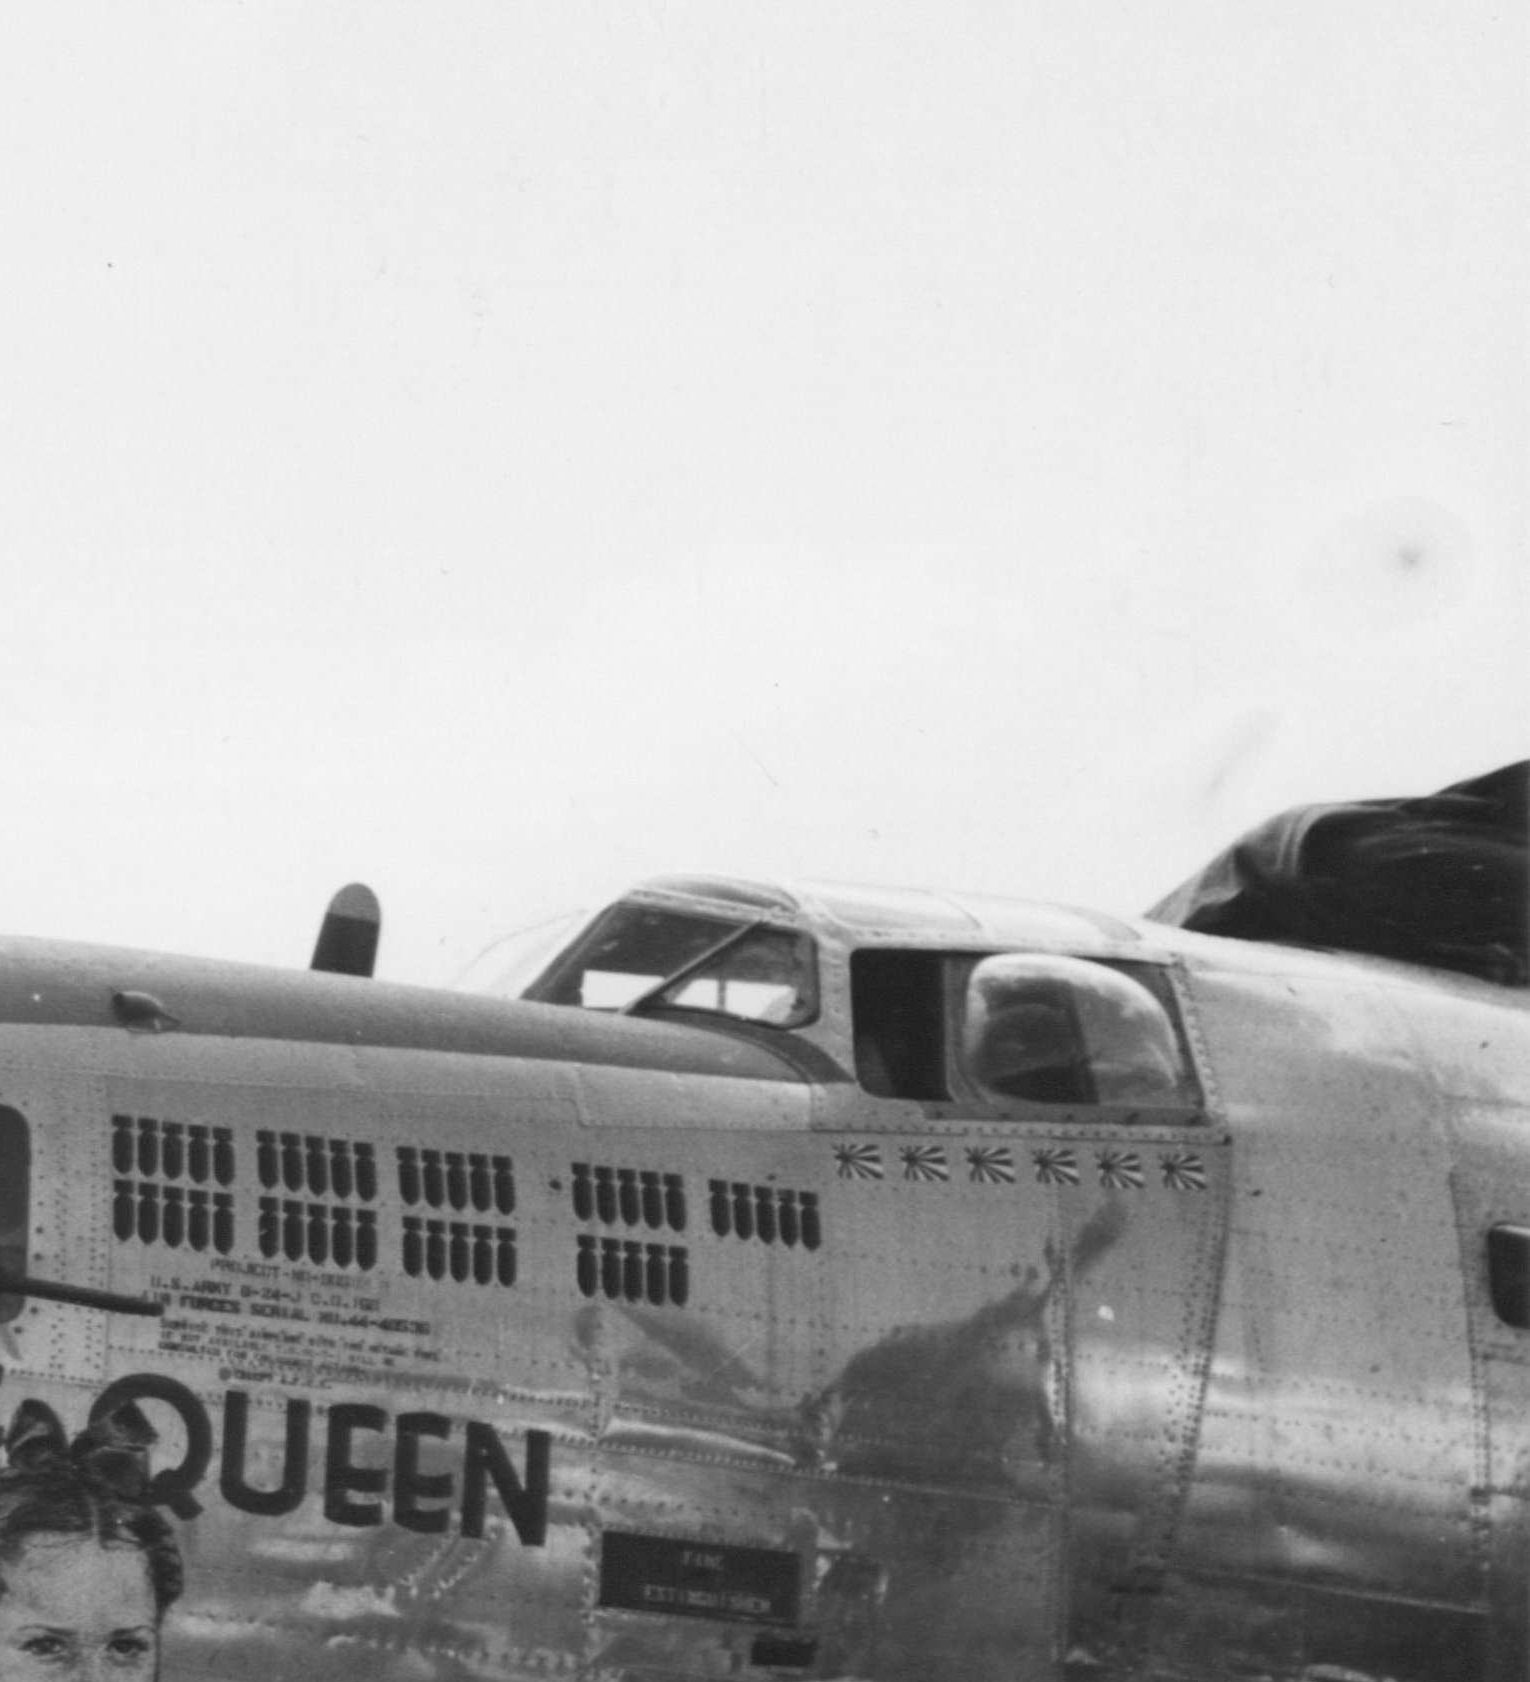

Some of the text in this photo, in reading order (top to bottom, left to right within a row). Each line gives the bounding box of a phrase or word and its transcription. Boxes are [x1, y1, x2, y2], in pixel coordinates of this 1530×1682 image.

[179, 1294, 240, 1314] FORCES
[249, 1302, 310, 1322] SERIAL
[87, 1373, 551, 1548] QUEEN
